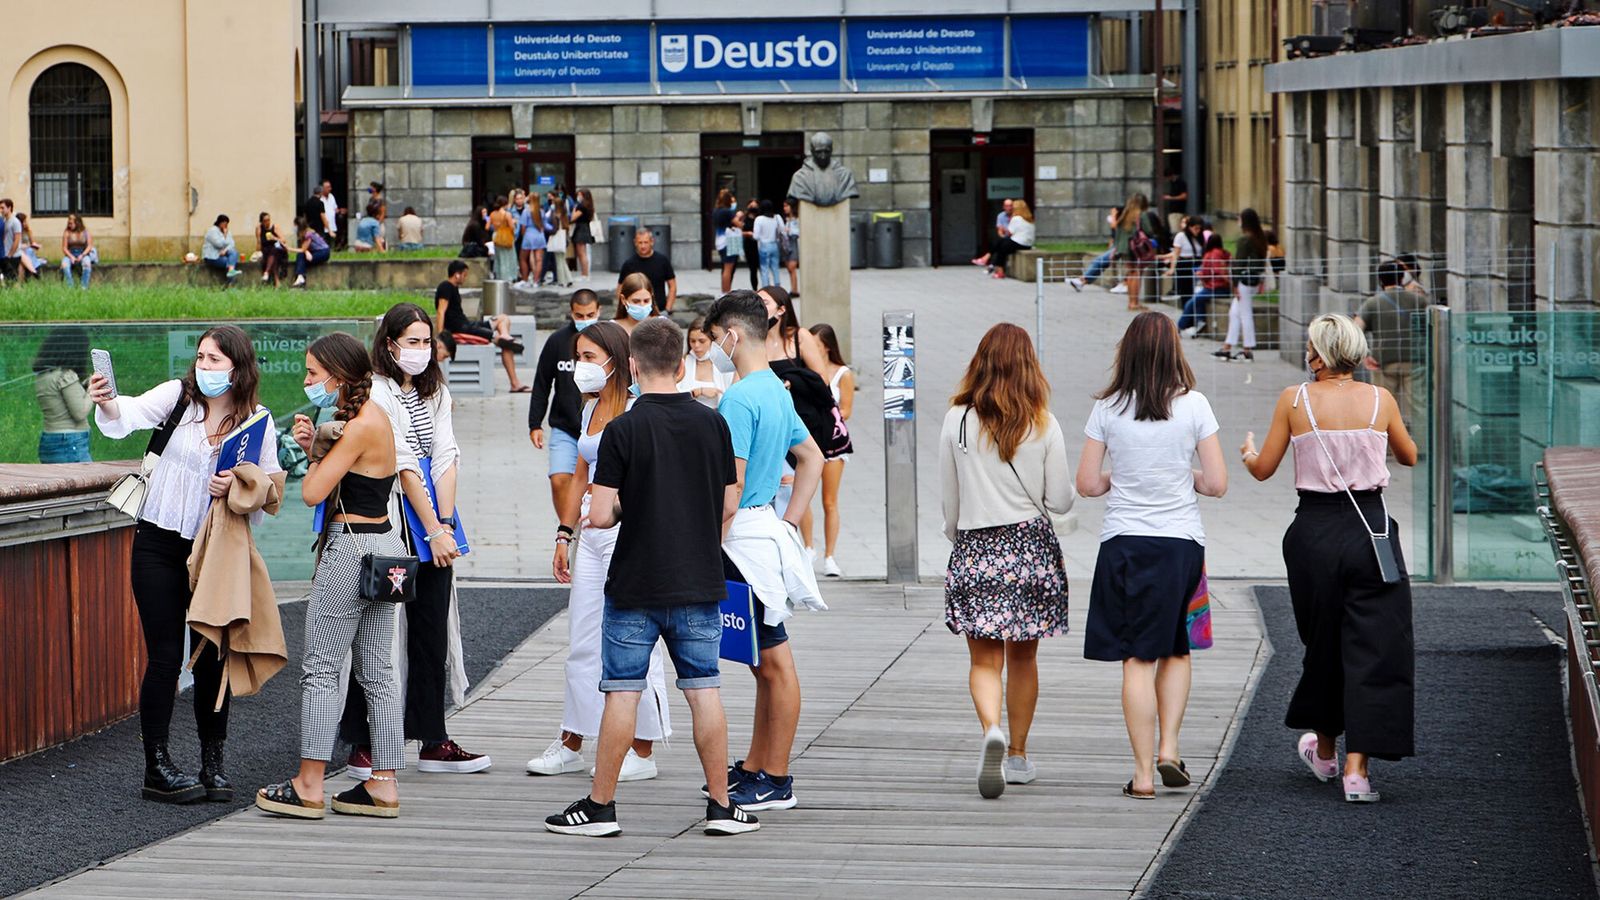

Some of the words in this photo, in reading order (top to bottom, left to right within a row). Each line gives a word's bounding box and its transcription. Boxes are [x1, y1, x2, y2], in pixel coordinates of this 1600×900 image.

[514, 34, 571, 44] Universidad
[573, 34, 585, 43] de
[587, 34, 622, 43] Deusto
[866, 29, 924, 39] Universidad
[926, 29, 939, 38] de
[941, 29, 975, 38] Deusto
[514, 51, 560, 60] Deustuko
[561, 50, 629, 60] Unibertsitatea
[693, 34, 838, 69] Deusto
[866, 46, 913, 55] Deustuko
[914, 44, 983, 54] Unibertsitatea
[514, 67, 557, 78] University
[558, 66, 568, 76] of
[569, 66, 601, 76] Deusto
[866, 62, 909, 73] University
[911, 61, 921, 71] of
[922, 61, 955, 71] Deusto
[557, 359, 575, 372] ad
[236, 433, 250, 466] sto
